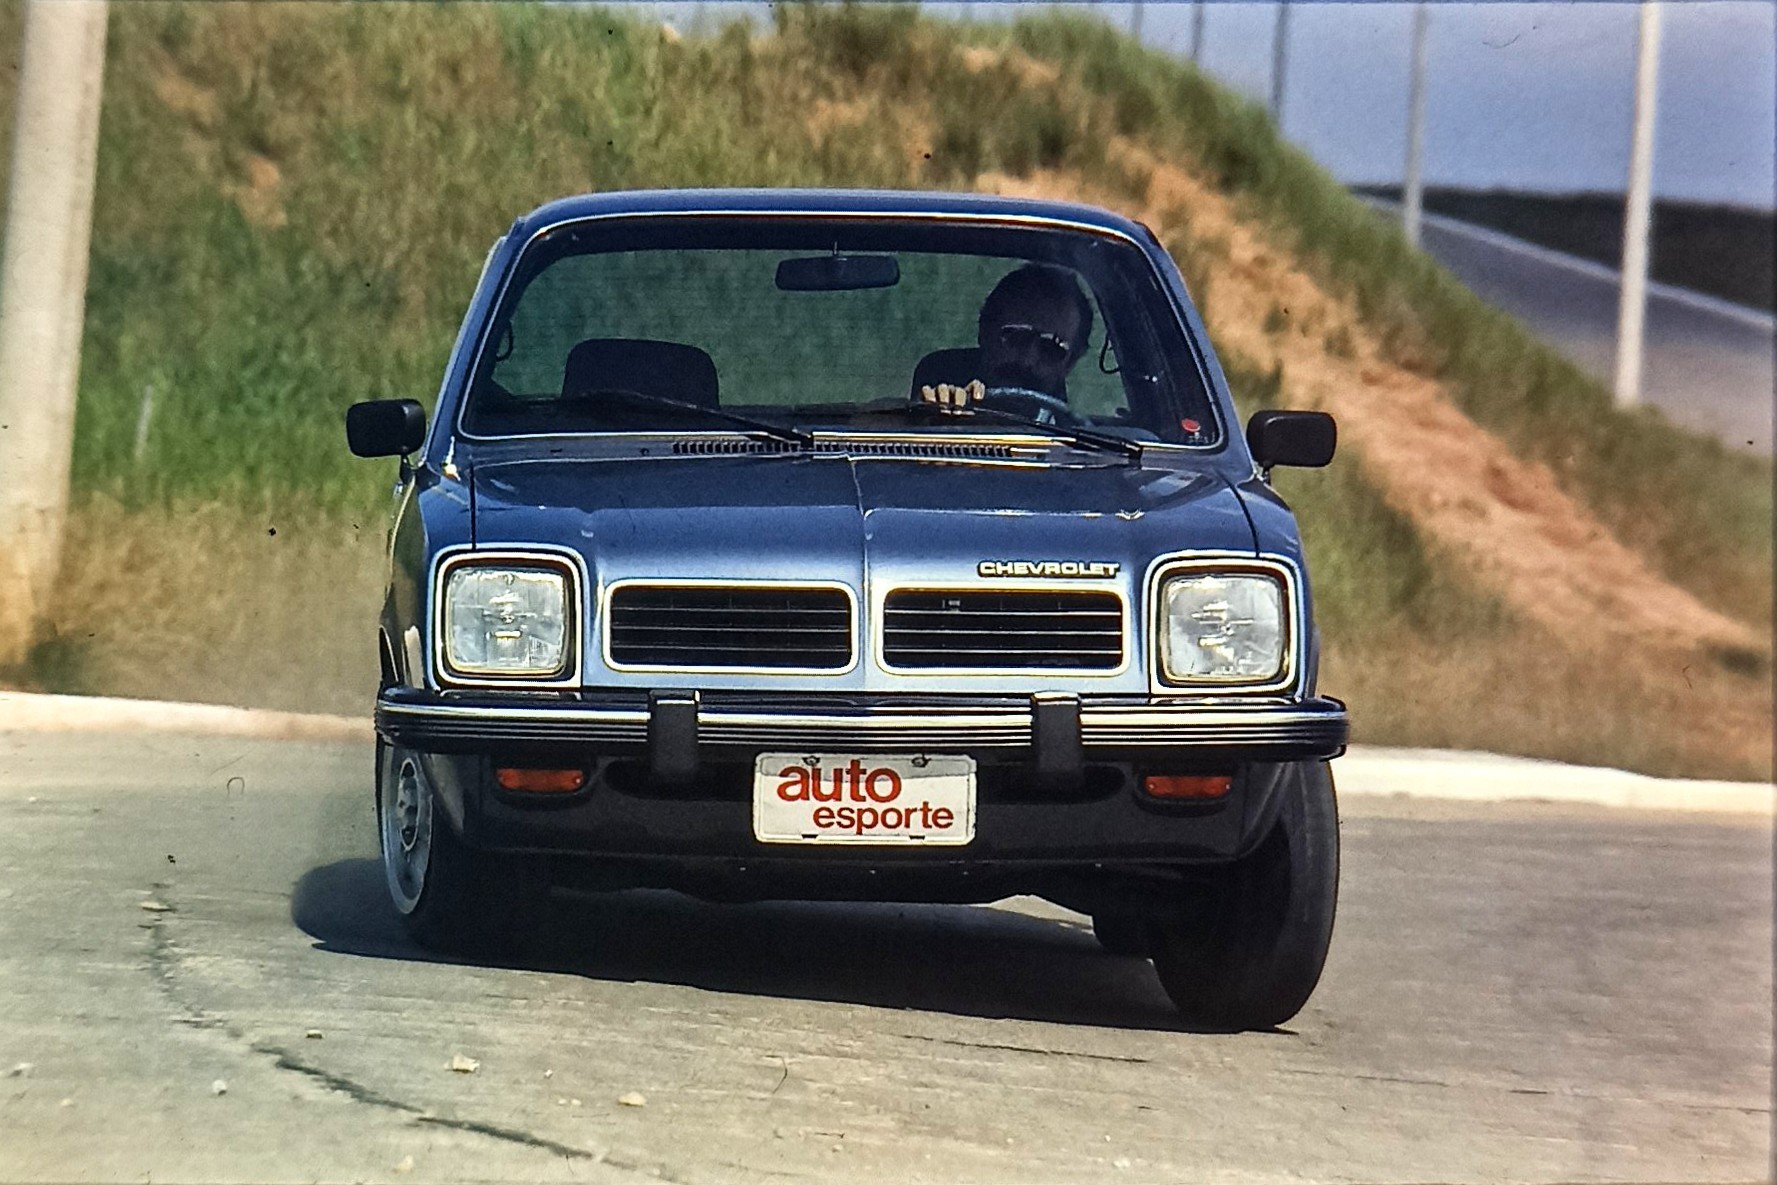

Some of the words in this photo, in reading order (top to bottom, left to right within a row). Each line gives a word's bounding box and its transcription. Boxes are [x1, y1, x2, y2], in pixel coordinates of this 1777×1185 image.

[978, 560, 1120, 578] CHEVROLET
[777, 759, 902, 803] auto
[813, 801, 954, 835] esporte
